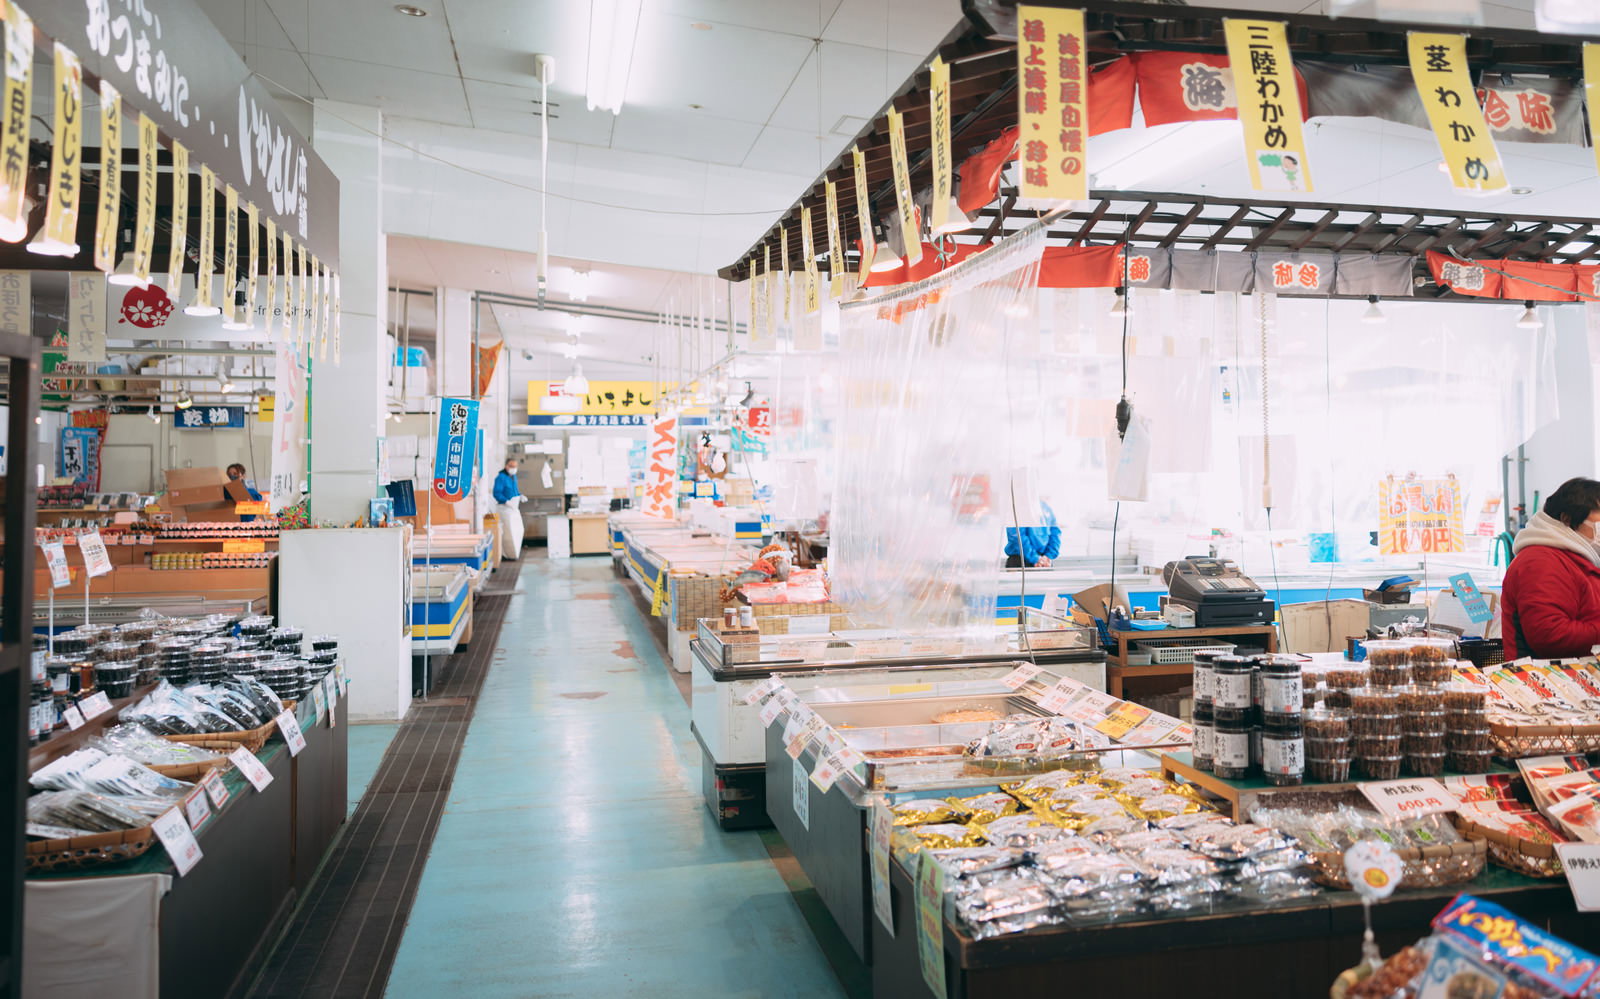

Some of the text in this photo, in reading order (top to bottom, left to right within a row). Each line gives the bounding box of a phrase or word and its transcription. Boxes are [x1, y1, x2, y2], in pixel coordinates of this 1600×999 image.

[1246, 24, 1288, 150] 三陸わかめ
[1423, 44, 1489, 182] 茎わかめ
[59, 82, 77, 209] ひじき
[183, 407, 230, 427] 乾物
[447, 404, 467, 489] 海鮮 市場通り
[1382, 783, 1425, 796] 酢昆布
